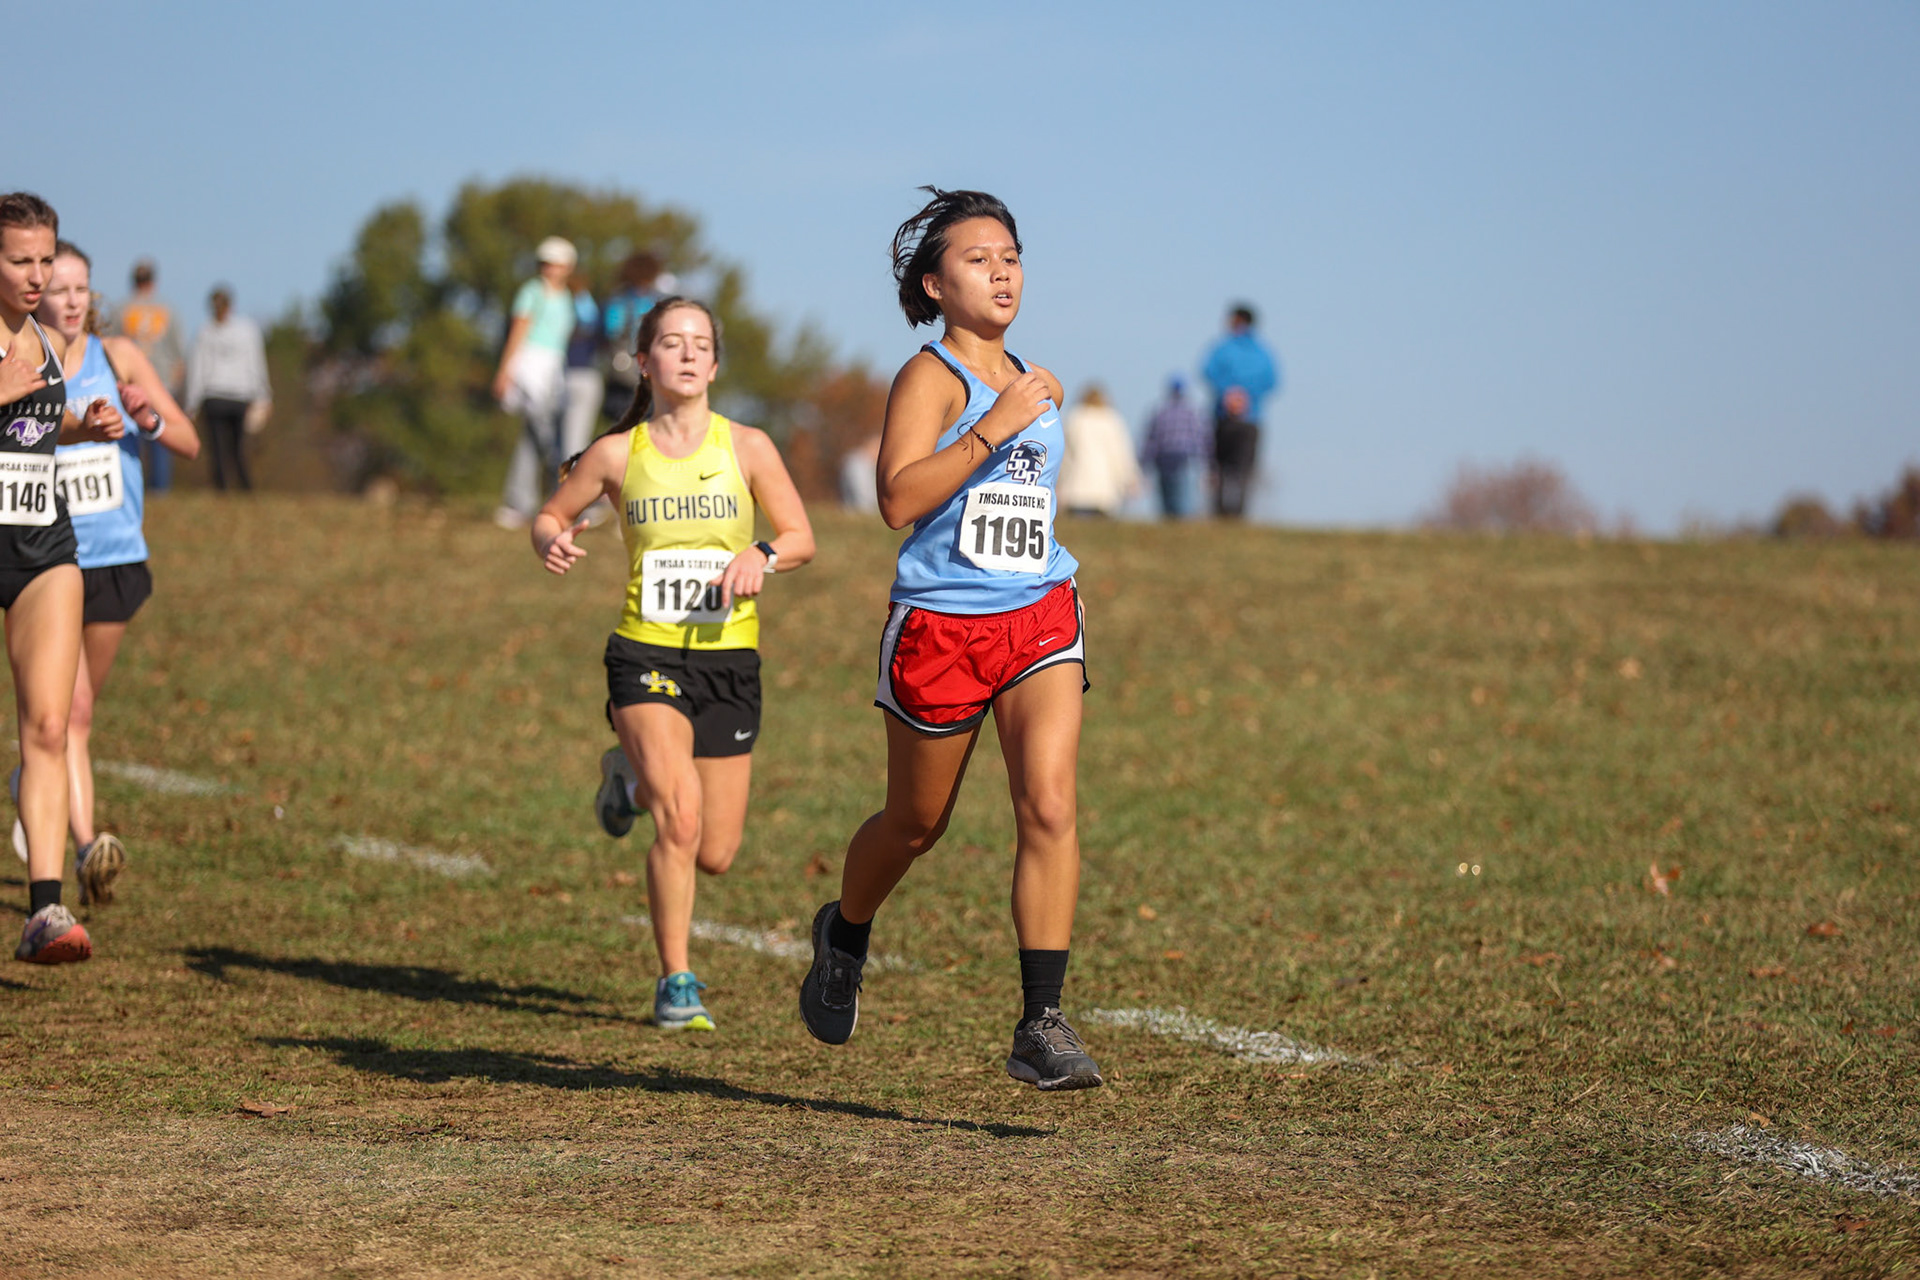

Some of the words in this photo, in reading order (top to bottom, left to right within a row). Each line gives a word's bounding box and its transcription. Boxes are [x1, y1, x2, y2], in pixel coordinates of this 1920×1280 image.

[58, 472, 113, 503] 1191
[978, 492, 1010, 506] TMSAA
[1012, 494, 1036, 509] STATE
[1036, 497, 1046, 510] XC
[625, 494, 738, 526] HUTCHISON
[971, 514, 1044, 560] 1195
[654, 559, 685, 570] TMSAA
[653, 579, 723, 611] 1120
